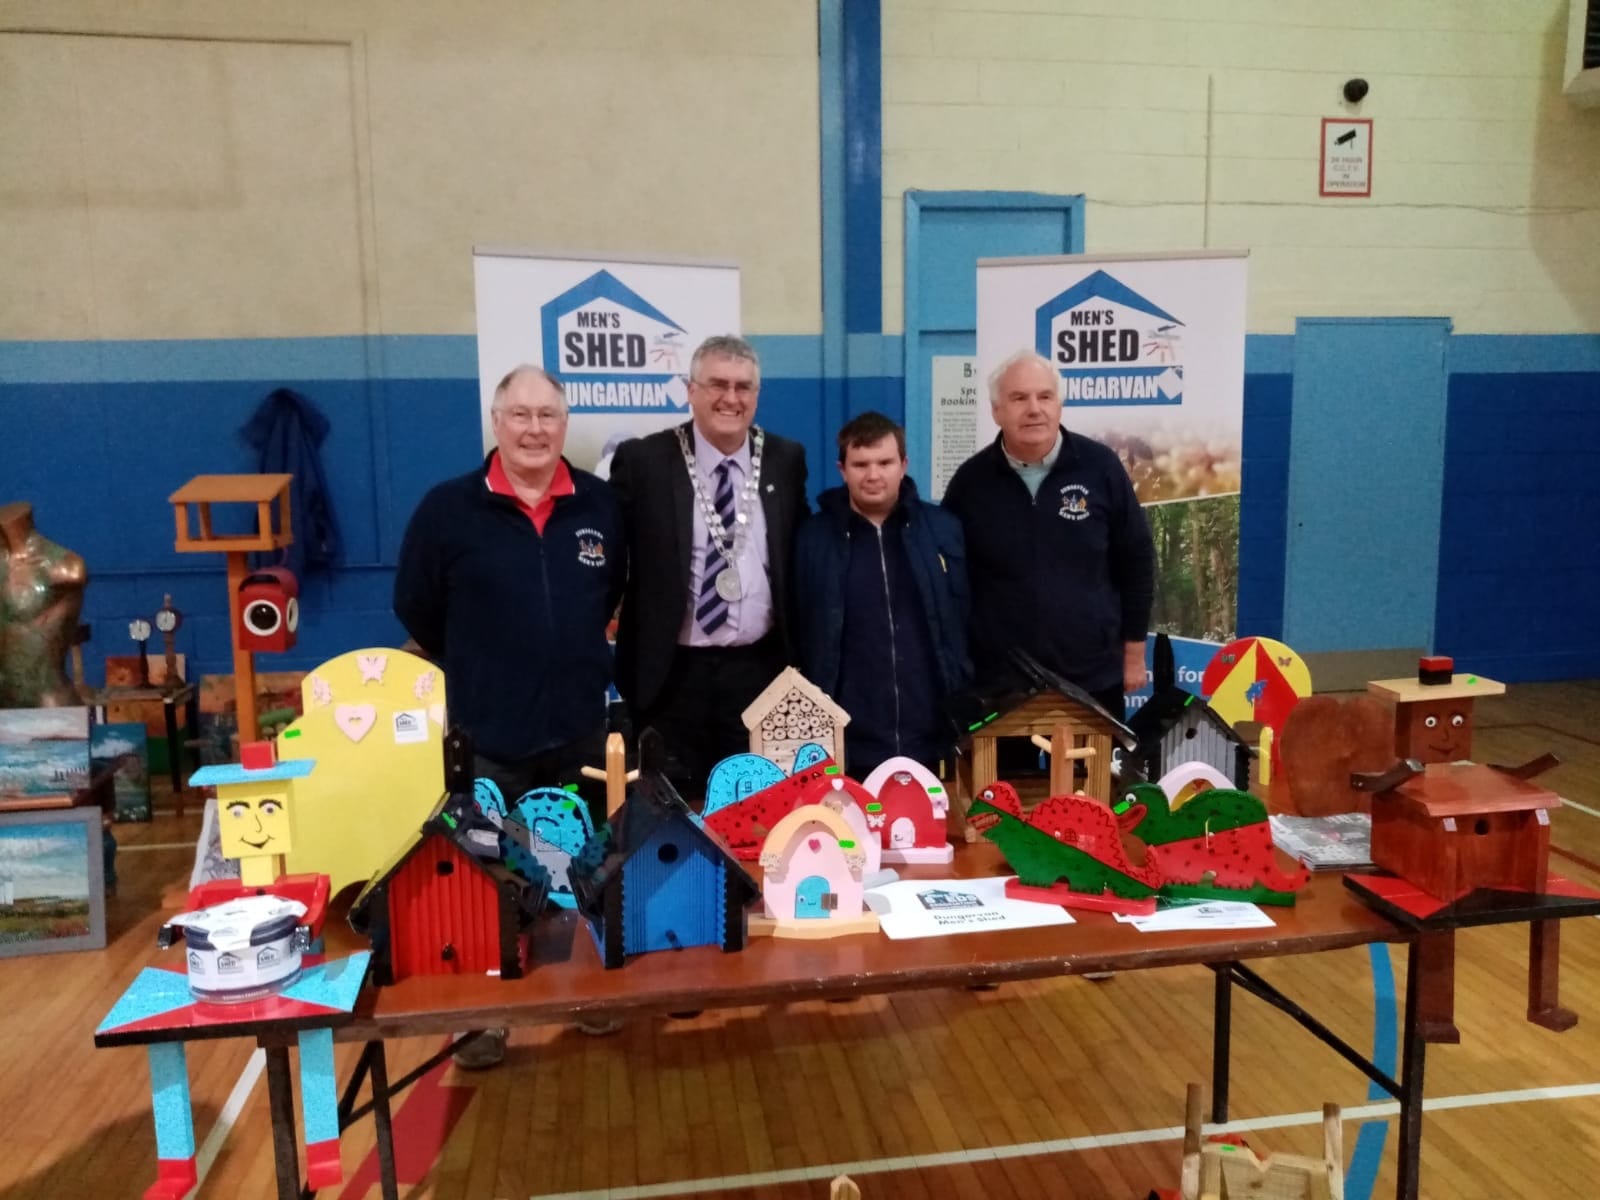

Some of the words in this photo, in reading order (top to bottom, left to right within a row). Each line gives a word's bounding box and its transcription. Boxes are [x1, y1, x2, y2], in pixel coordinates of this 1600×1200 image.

[577, 311, 621, 329] MEN'S
[1070, 309, 1115, 326] MEN'S
[564, 331, 647, 369] SHED
[1056, 328, 1140, 364] SHED
[561, 381, 668, 408] UNGARVAN
[1061, 375, 1158, 401] NGARVAN
